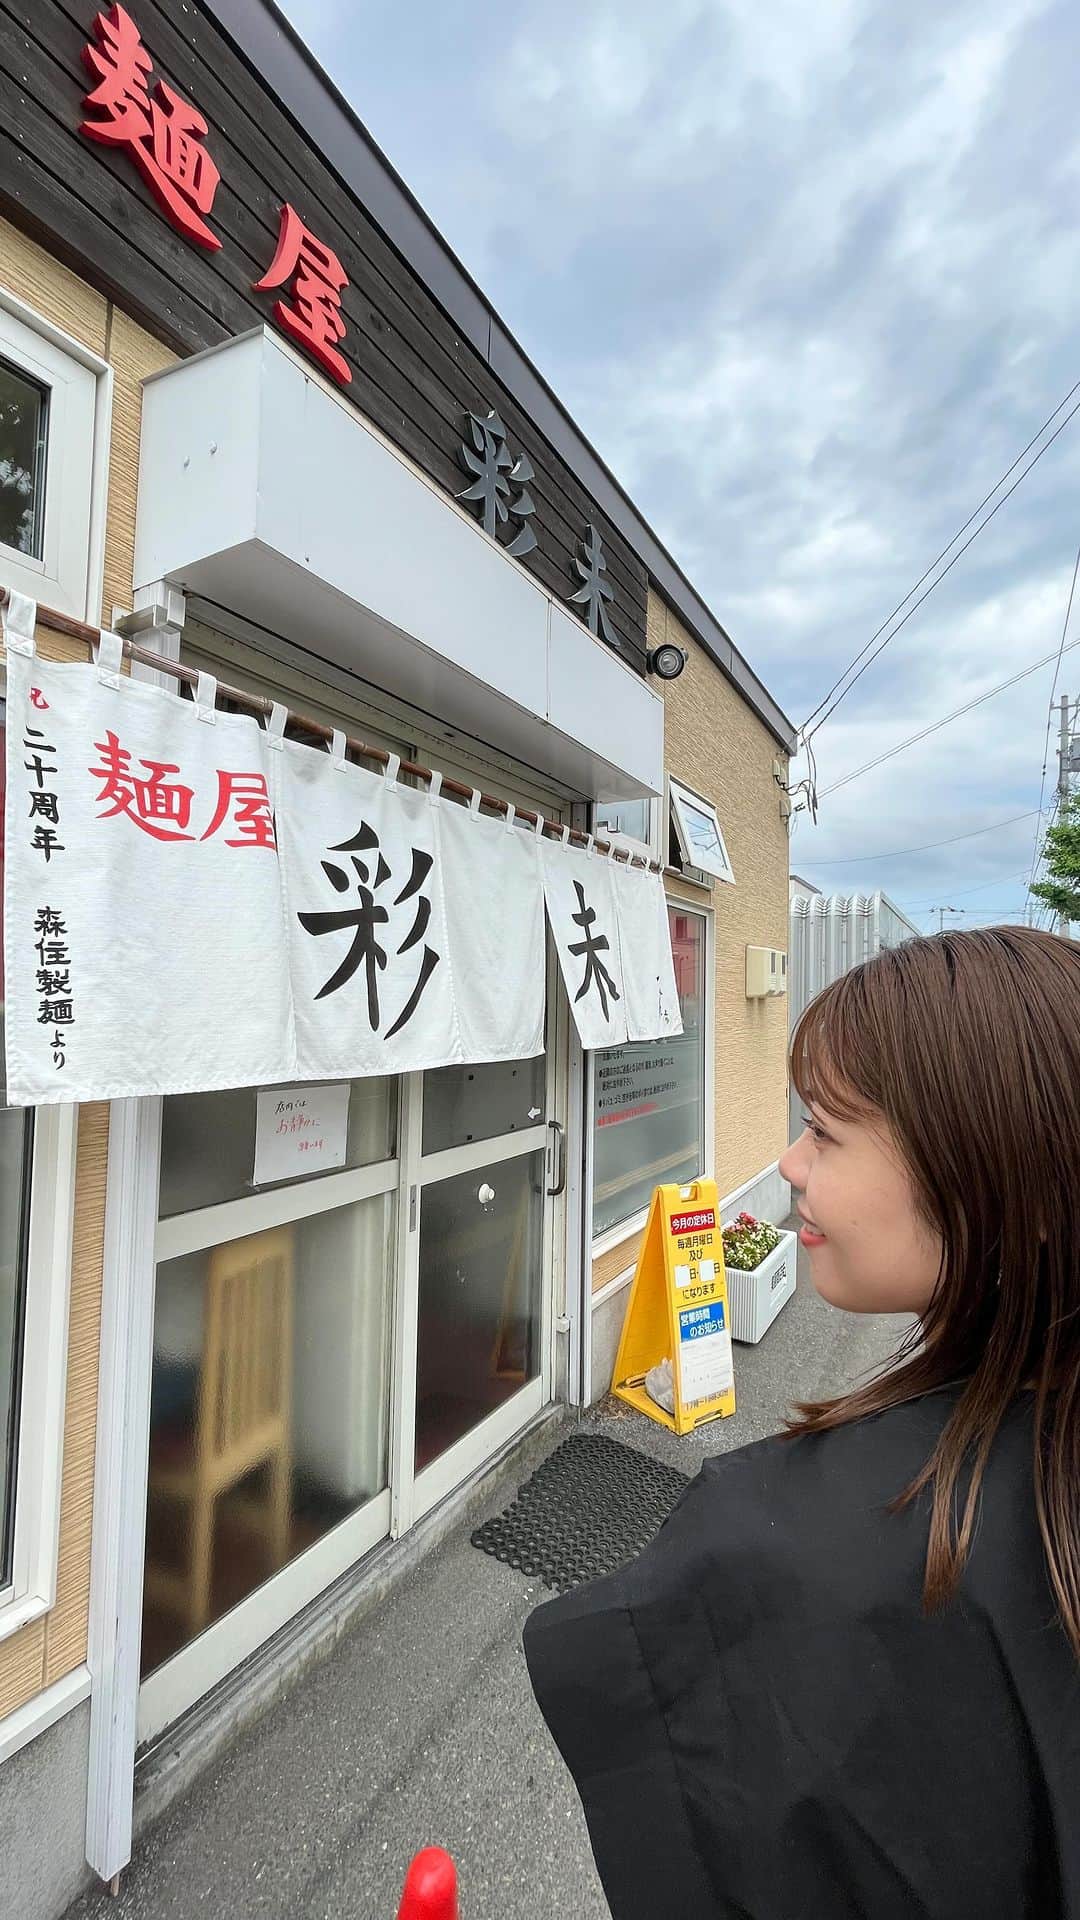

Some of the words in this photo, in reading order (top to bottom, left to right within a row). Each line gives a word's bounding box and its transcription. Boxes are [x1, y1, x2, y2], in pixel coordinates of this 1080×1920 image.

[23, 725, 66, 863] 二十周年
[88, 729, 279, 851] 麺屋
[34, 905, 76, 1071] 森住製麺より
[672, 1212, 715, 1231] 今月の定休日
[677, 1233, 713, 1250] 毎週月曜日
[689, 1248, 703, 1262] 及び
[682, 1283, 716, 1300] になります
[680, 1307, 711, 1327] 営業時間
[689, 1319, 724, 1338] のお知らせ
